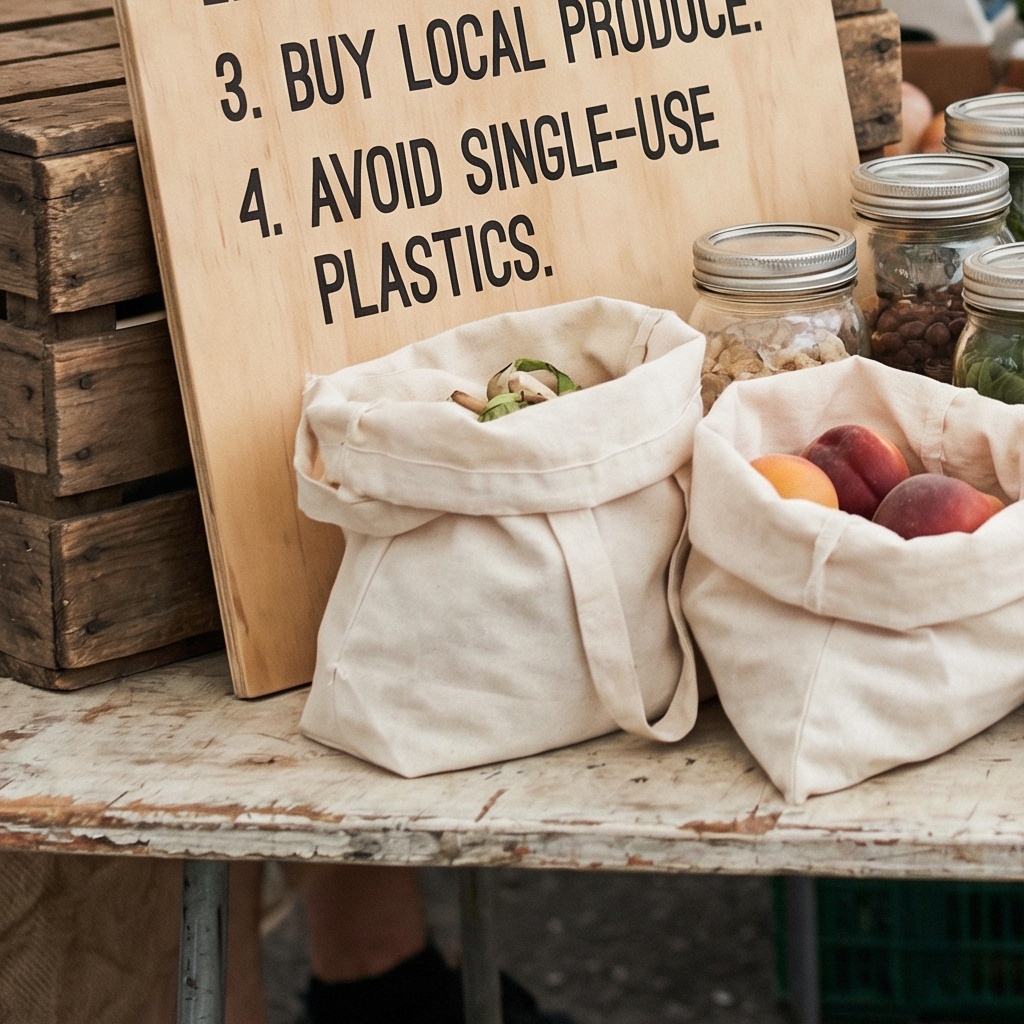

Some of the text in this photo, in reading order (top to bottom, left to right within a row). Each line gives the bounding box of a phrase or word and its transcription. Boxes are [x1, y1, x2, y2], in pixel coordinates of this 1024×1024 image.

[215, 52, 263, 122] 3.
[280, 28, 376, 112] BUY
[397, 5, 547, 92] LOCAL
[239, 84, 720, 239] 4. AVOID SINGLE-USE
[313, 214, 554, 325] PLASTICS.
